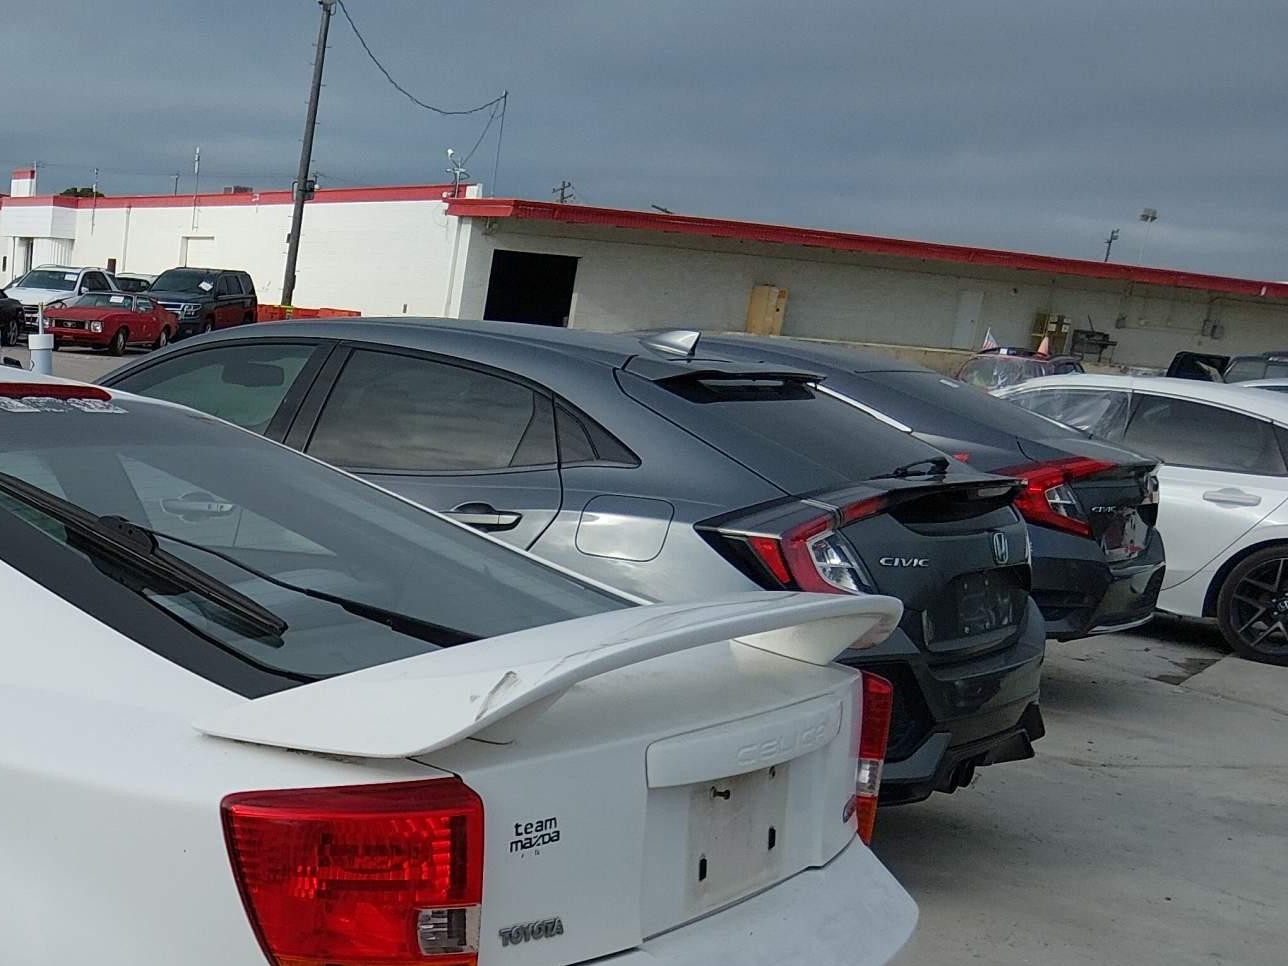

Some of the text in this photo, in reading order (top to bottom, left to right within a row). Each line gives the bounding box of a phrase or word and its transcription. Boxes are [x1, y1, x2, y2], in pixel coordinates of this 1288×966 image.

[879, 557, 929, 567] CIVIC
[514, 817, 557, 836] team
[509, 830, 560, 853] mazda
[498, 917, 564, 947] TOYOTA
